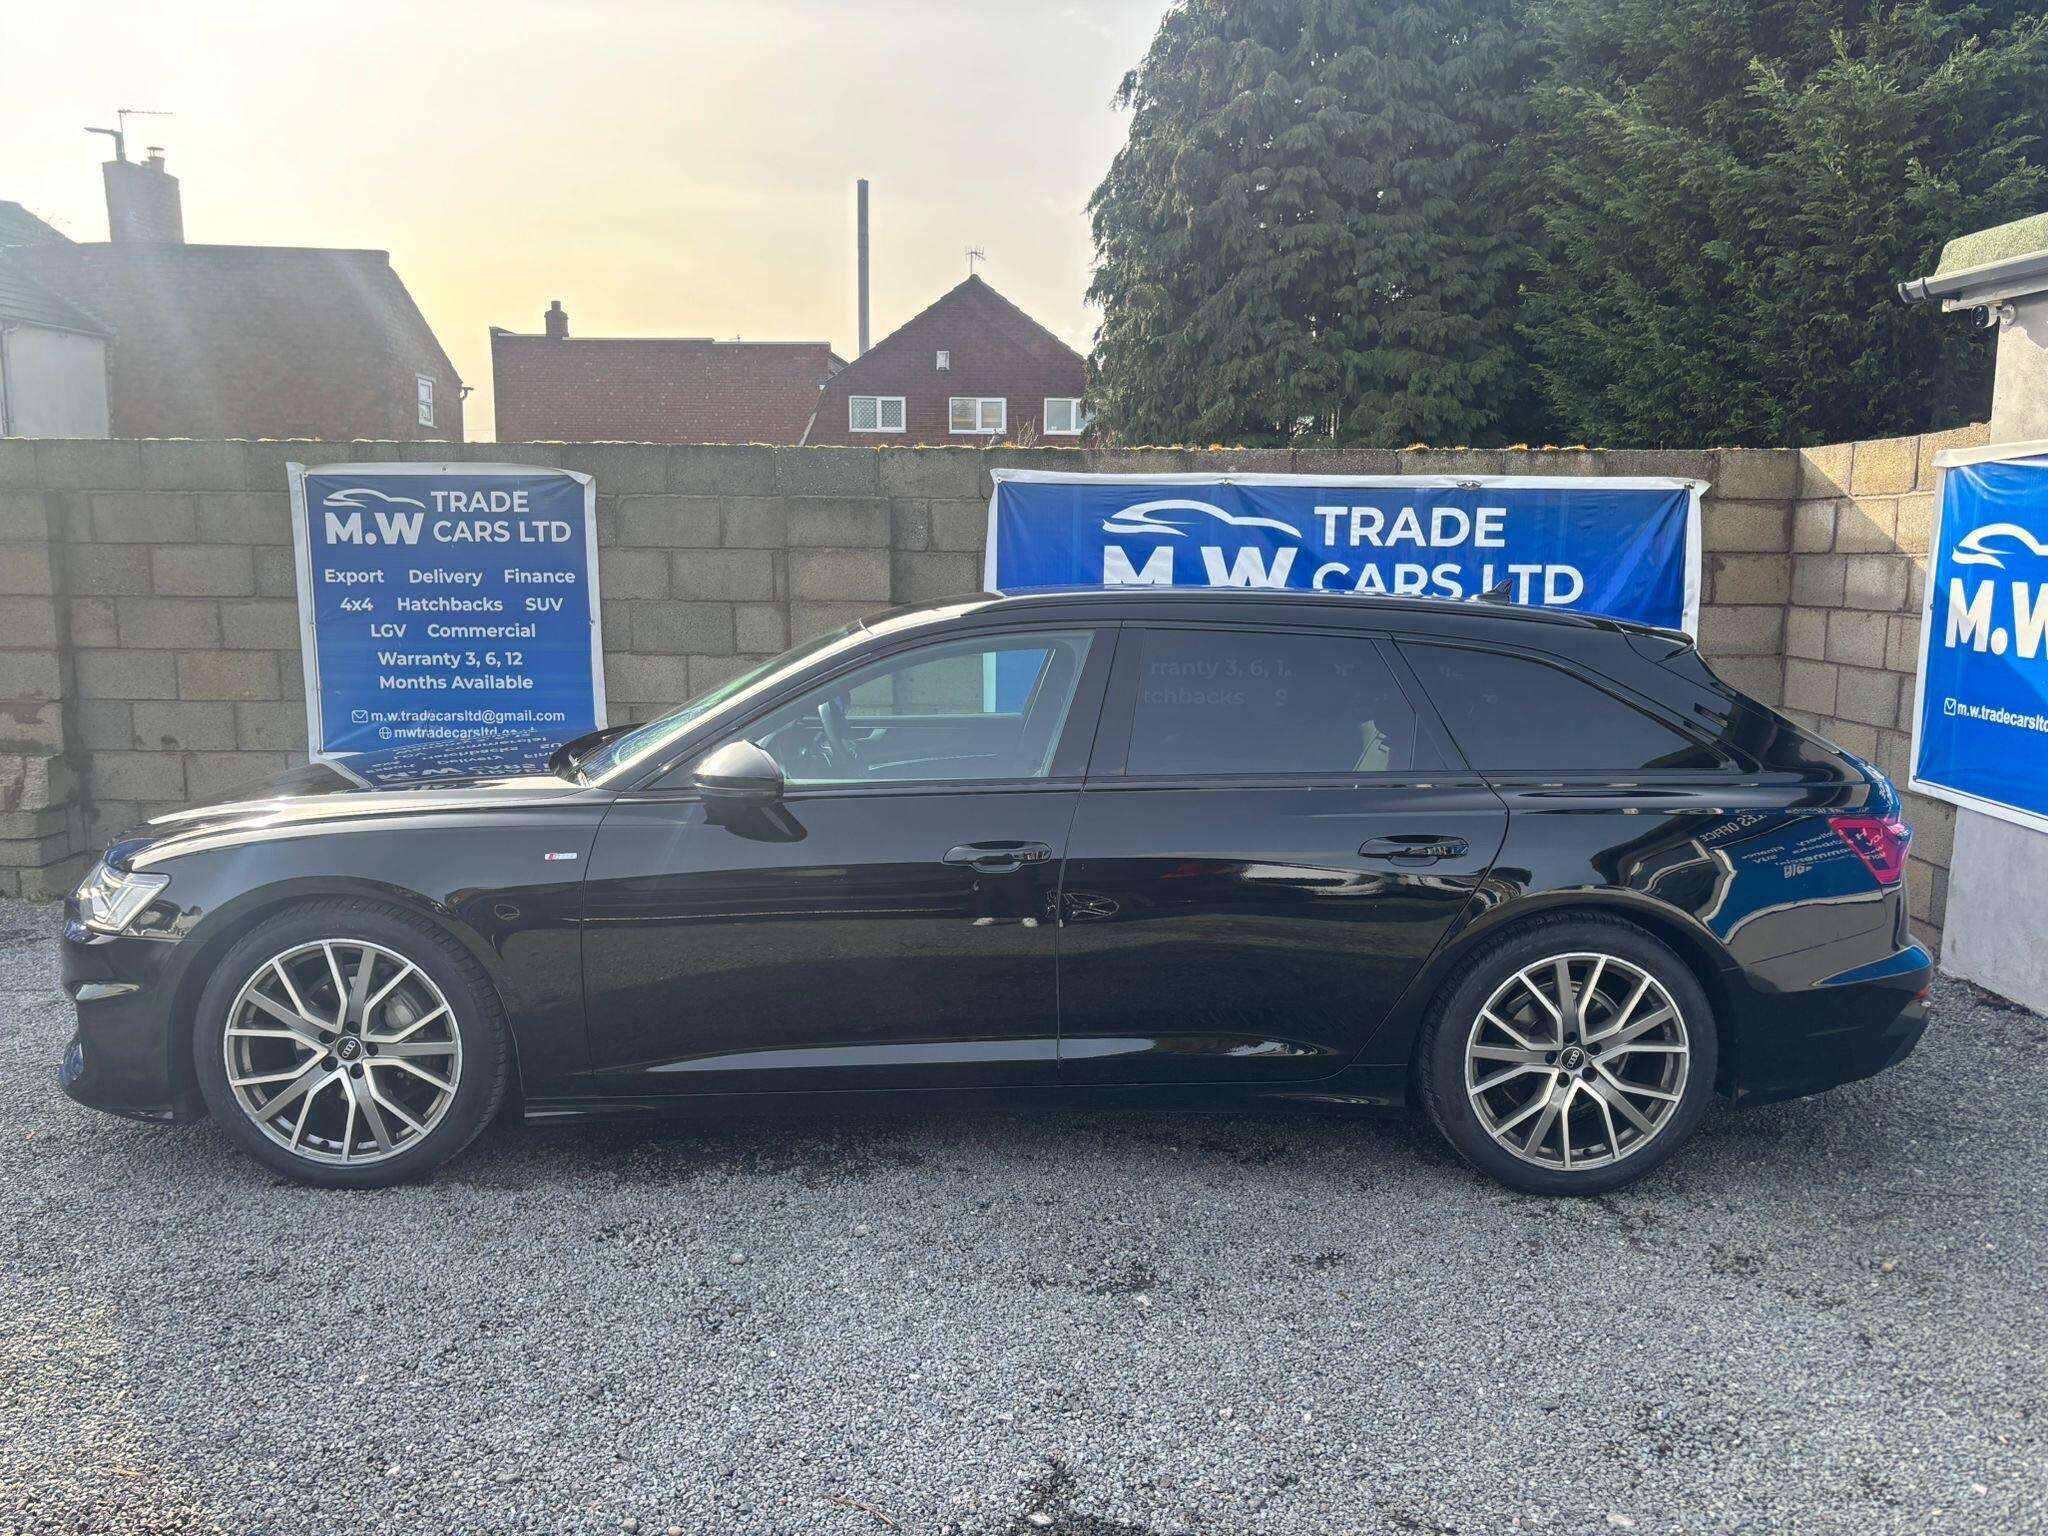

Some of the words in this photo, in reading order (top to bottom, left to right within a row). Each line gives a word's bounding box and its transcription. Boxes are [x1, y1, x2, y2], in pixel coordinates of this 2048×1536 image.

[430, 491, 529, 513] TRADE
[325, 512, 424, 545] M.W
[433, 520, 511, 543] CARS
[519, 521, 572, 543] LTD
[1314, 506, 1507, 548] TRADE
[1104, 545, 1298, 588] MW
[324, 568, 384, 586] Export
[409, 568, 483, 587] Delivery
[504, 568, 576, 583] Finance
[1312, 562, 1463, 600] CARS
[340, 597, 374, 611] 4x4
[397, 596, 503, 611] Hatchbacks
[525, 597, 563, 611] SUV
[370, 623, 407, 638] LGV
[427, 622, 536, 638] Commercial
[378, 651, 461, 669] Warranty
[465, 651, 480, 668] 3,
[485, 651, 501, 668] 6,
[504, 651, 523, 666] 12
[379, 675, 447, 690] Months
[451, 674, 533, 690] Available
[371, 708, 565, 725] m.w.tradecarsltd@gmail.com
